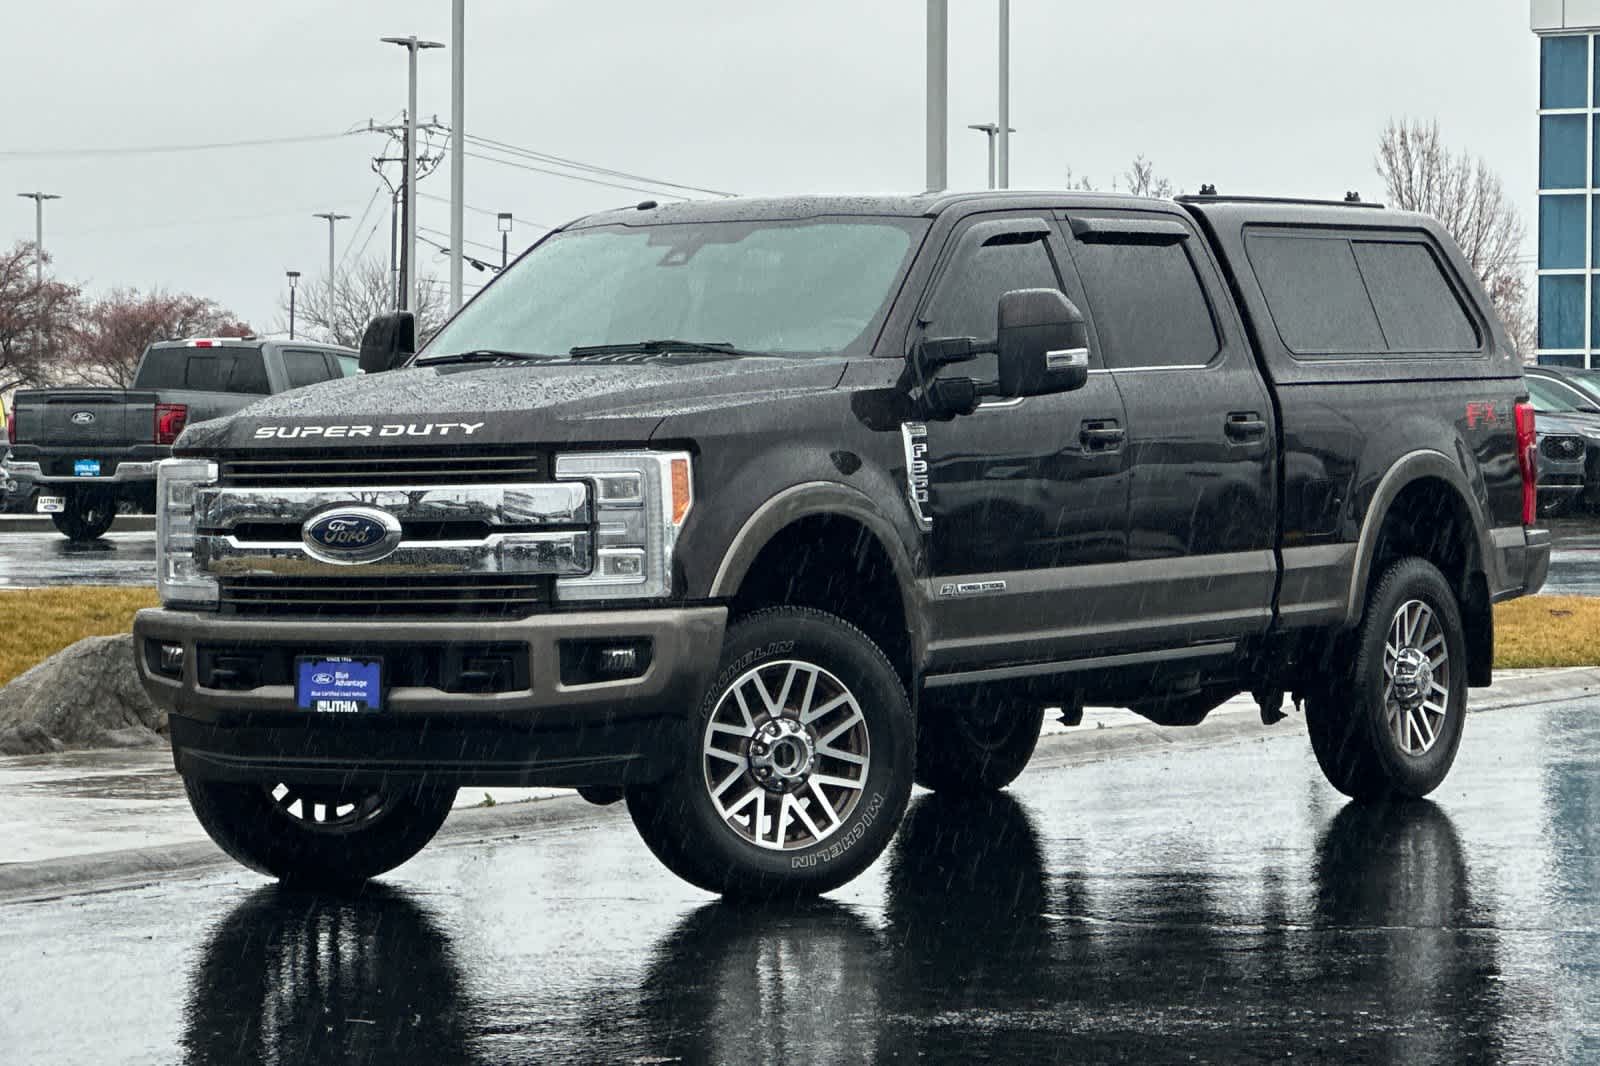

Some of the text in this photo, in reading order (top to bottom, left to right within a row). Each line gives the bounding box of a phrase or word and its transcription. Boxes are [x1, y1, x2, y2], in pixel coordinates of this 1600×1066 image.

[254, 422, 485, 439] SUPER DUTY
[323, 519, 371, 544] Ford
[335, 671, 349, 679] Blue
[334, 680, 368, 688] Advantage
[327, 700, 358, 712] LITHIA
[791, 792, 885, 869] MICHELIN
